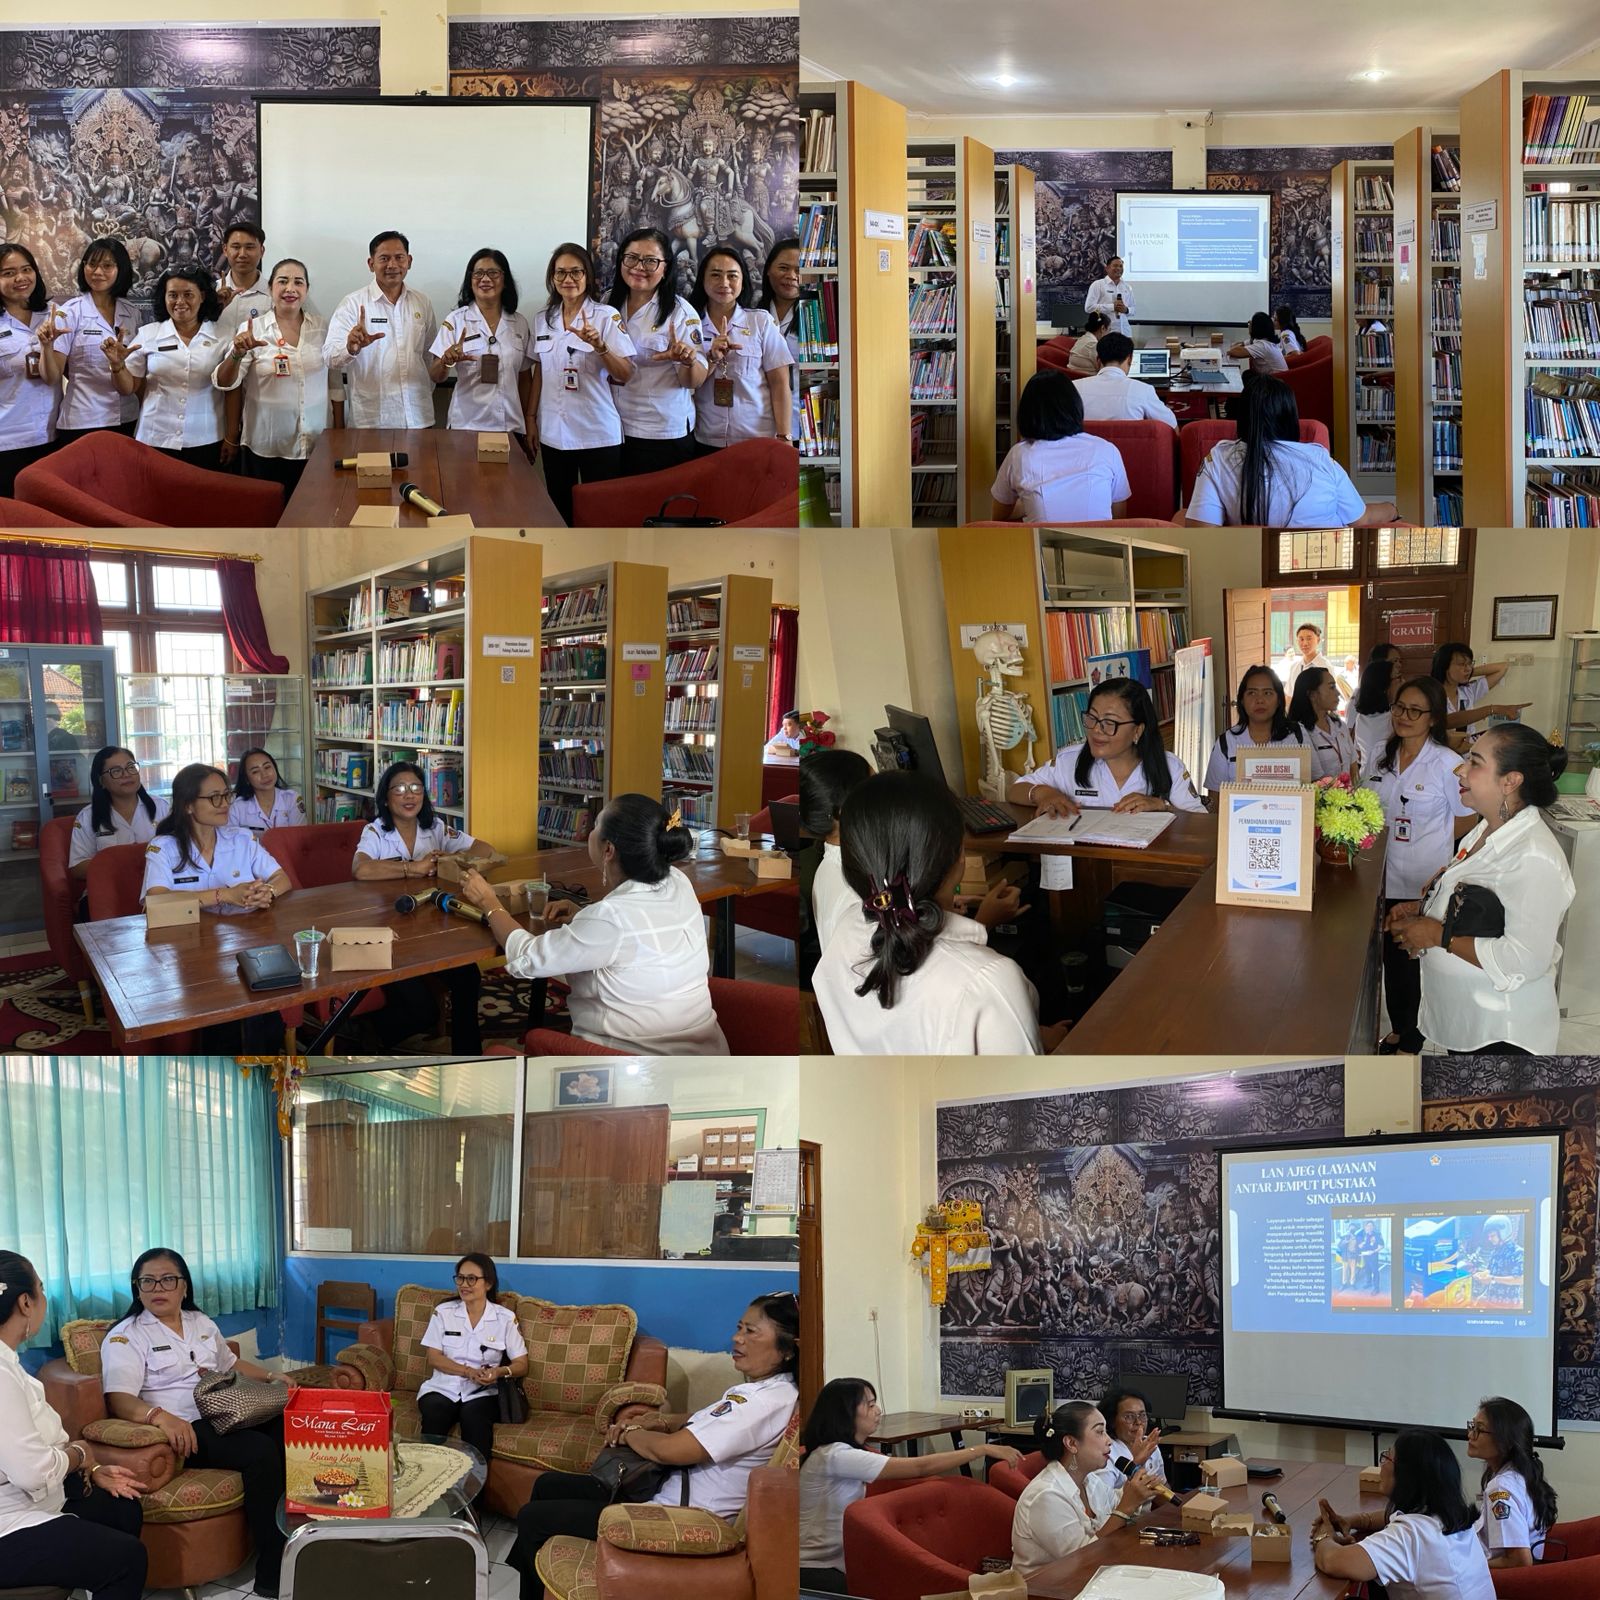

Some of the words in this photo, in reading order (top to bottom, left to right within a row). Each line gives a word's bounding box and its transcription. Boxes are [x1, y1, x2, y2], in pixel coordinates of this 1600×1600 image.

[1392, 626, 1432, 637] GRATIS
[1255, 765, 1272, 774] SCAN
[1238, 818, 1268, 826] PERMOHONAN
[1267, 819, 1292, 827] INFORMASI
[1261, 1167, 1284, 1179] LAN
[1286, 1165, 1315, 1178] AJEG
[1317, 1161, 1377, 1179] (LAYANAN
[1234, 1182, 1272, 1194] ANTAR
[1273, 1179, 1319, 1193] JEMPUT
[1321, 1176, 1377, 1190] PUSTAKA
[1306, 1191, 1377, 1206] SINGARAJA)
